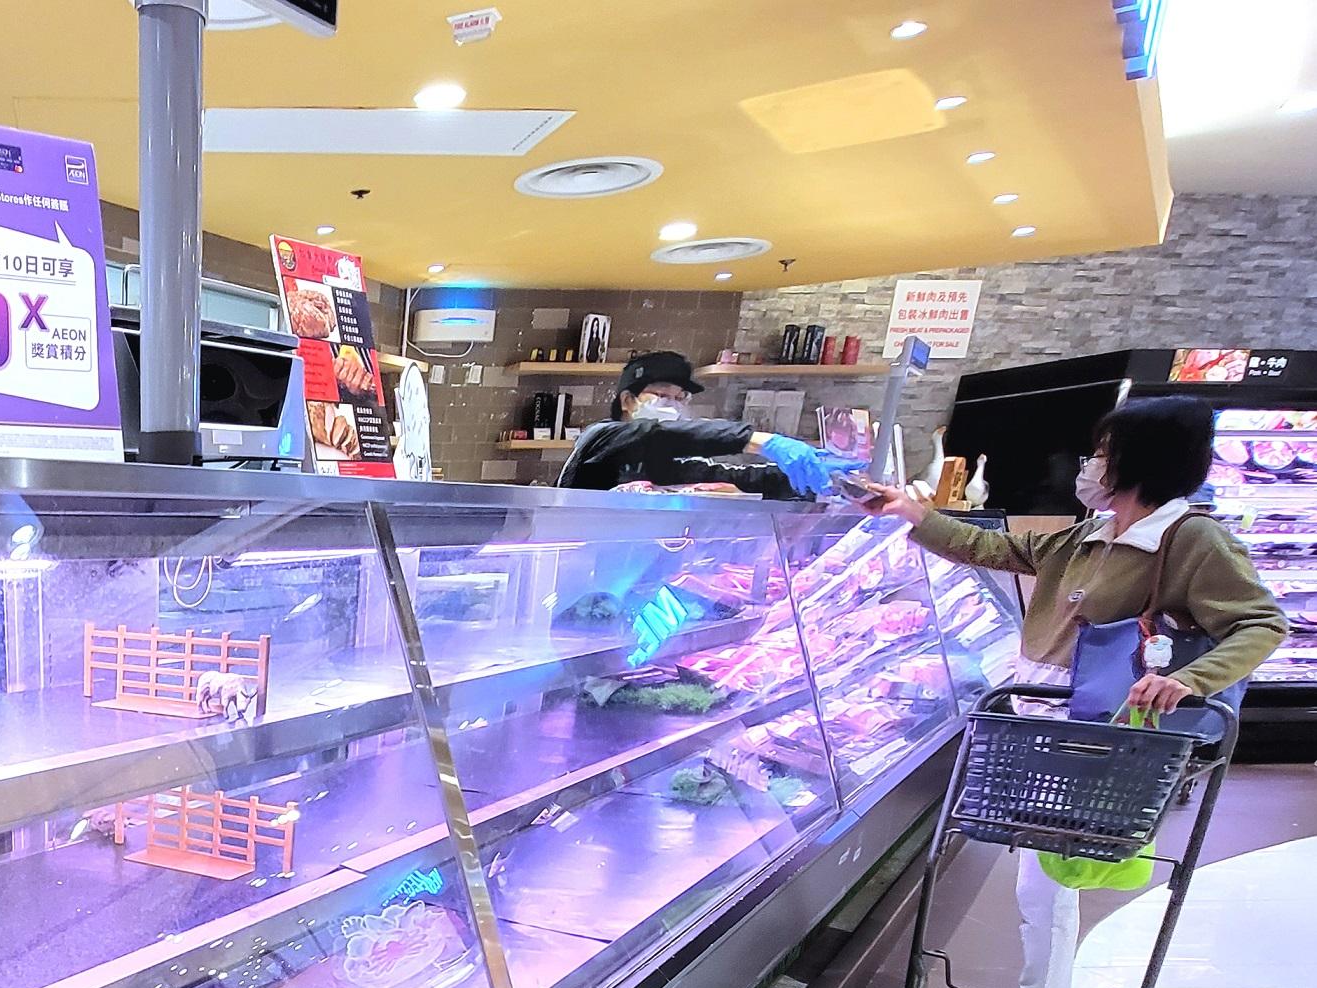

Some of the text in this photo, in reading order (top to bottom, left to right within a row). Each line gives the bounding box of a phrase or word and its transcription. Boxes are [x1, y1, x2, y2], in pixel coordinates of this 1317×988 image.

[51, 327, 87, 342] AEON
[30, 342, 87, 362] 獎賞積分
